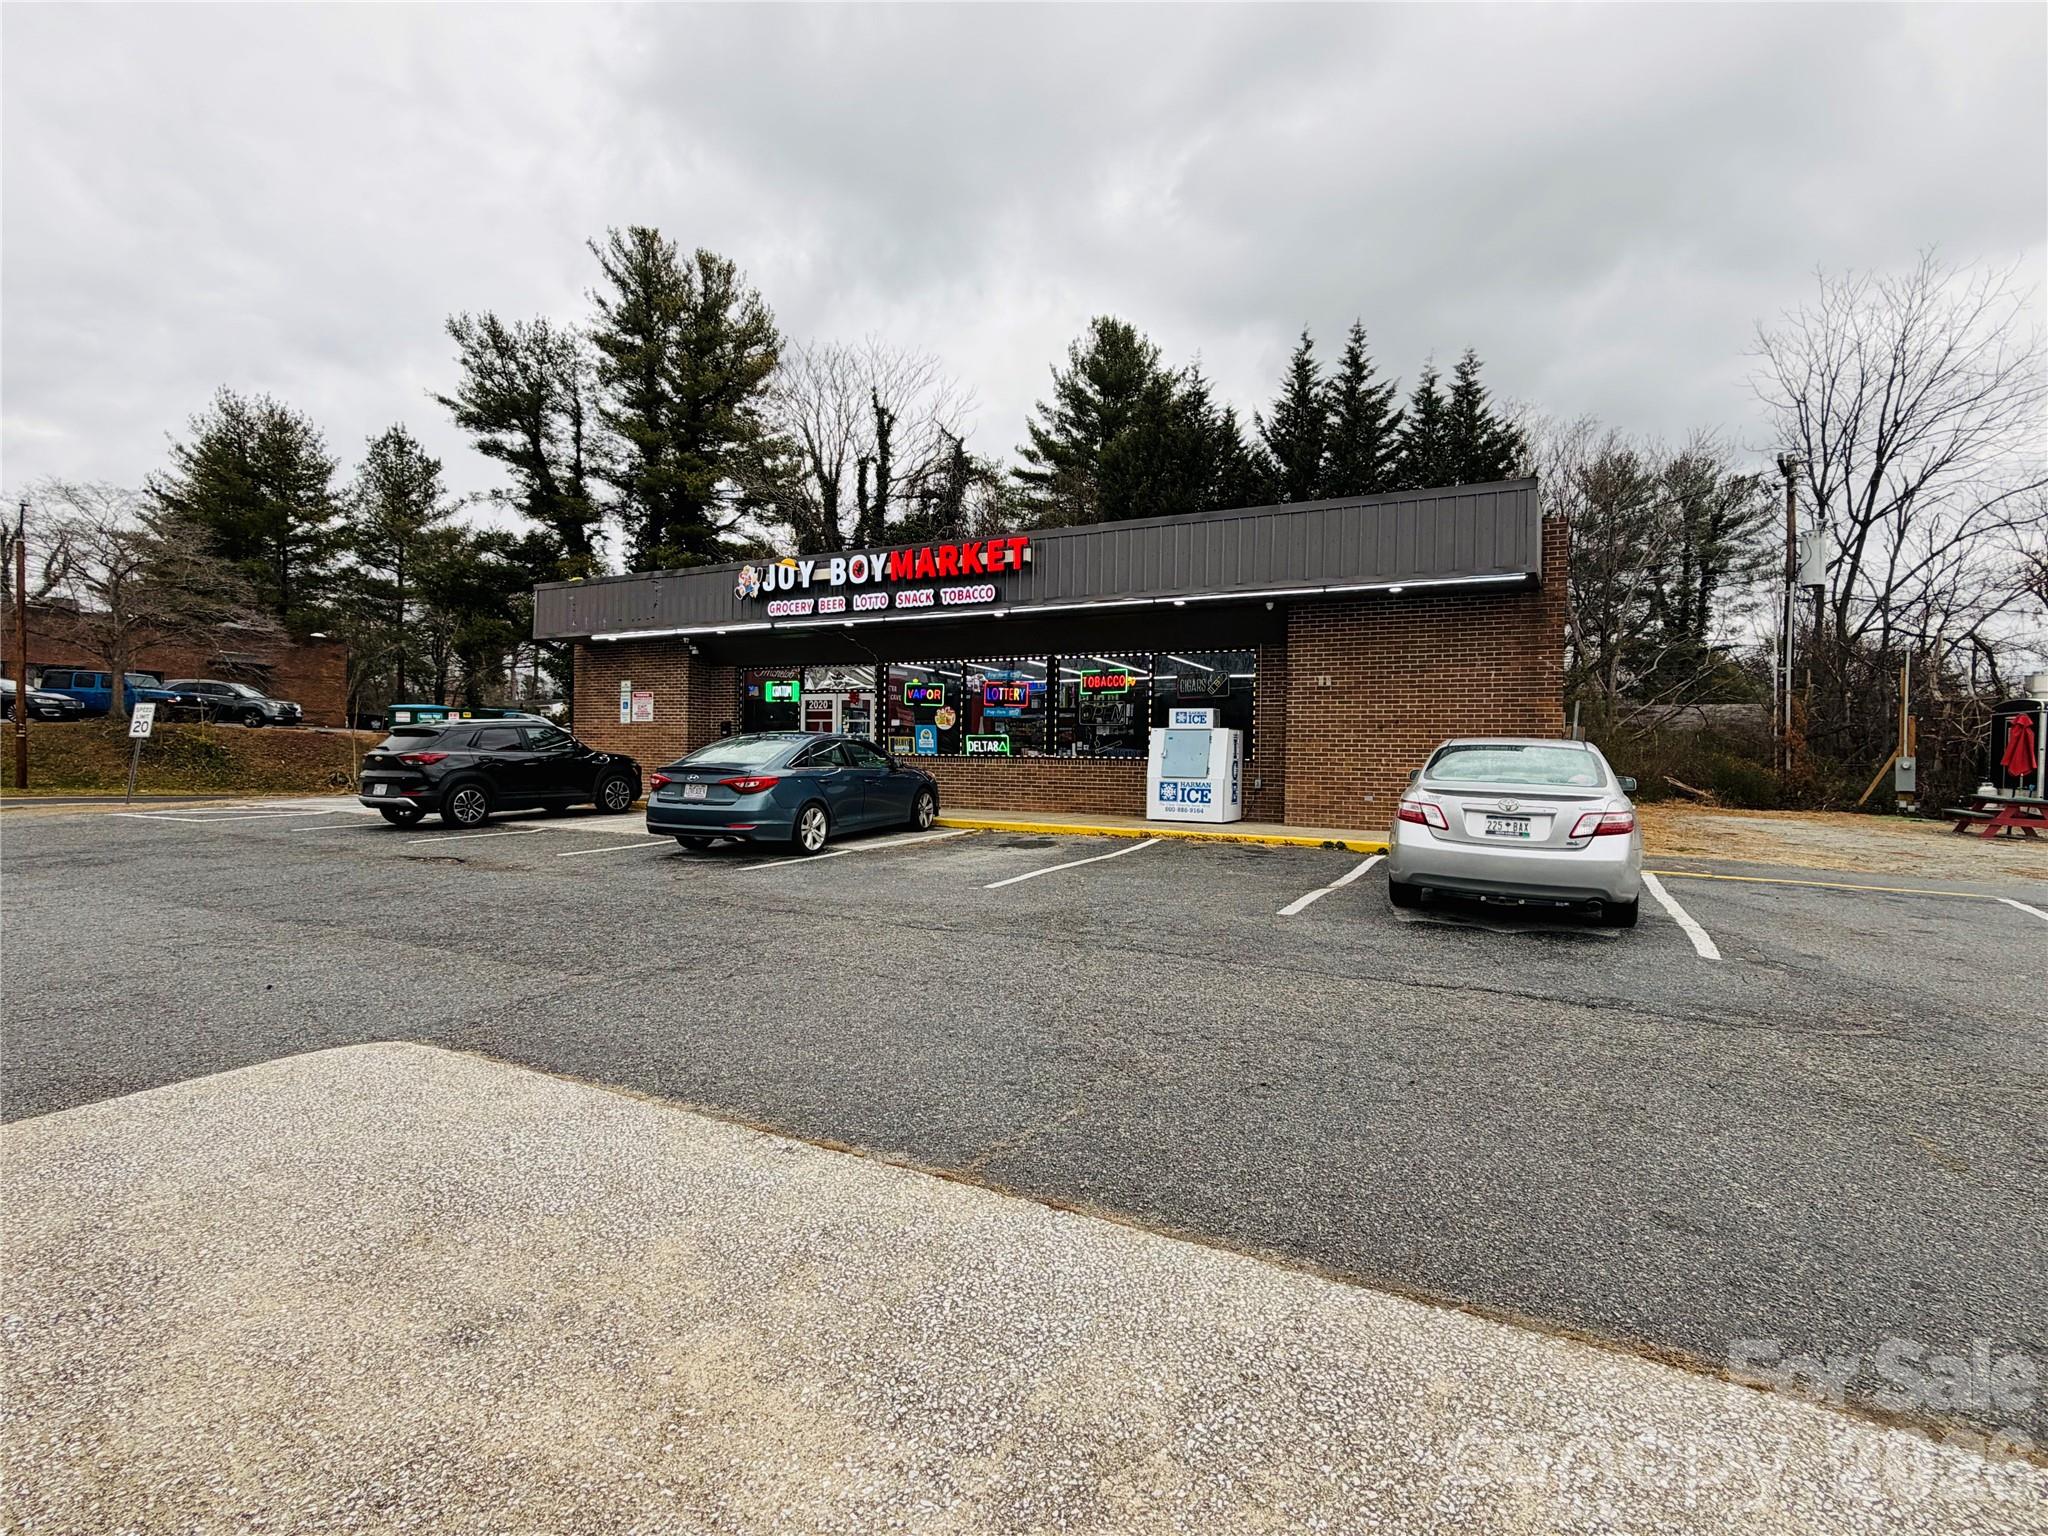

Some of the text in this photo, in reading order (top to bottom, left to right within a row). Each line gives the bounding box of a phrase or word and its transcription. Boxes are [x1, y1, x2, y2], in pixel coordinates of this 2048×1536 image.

[762, 557, 815, 593] JOY
[768, 584, 996, 616] GROCERY BEER LOTTO SNACK TOBACCO
[1082, 675, 1126, 689] TOBACCO
[1180, 678, 1207, 693] CIGARS
[907, 688, 941, 700] VAPOR
[986, 687, 1026, 701] LOTTERY
[808, 700, 829, 709] 2020
[132, 721, 149, 732] 20
[1188, 715, 1207, 724] ICE
[1179, 788, 1212, 804] ICE
[1487, 820, 1529, 832] 225 BAX
